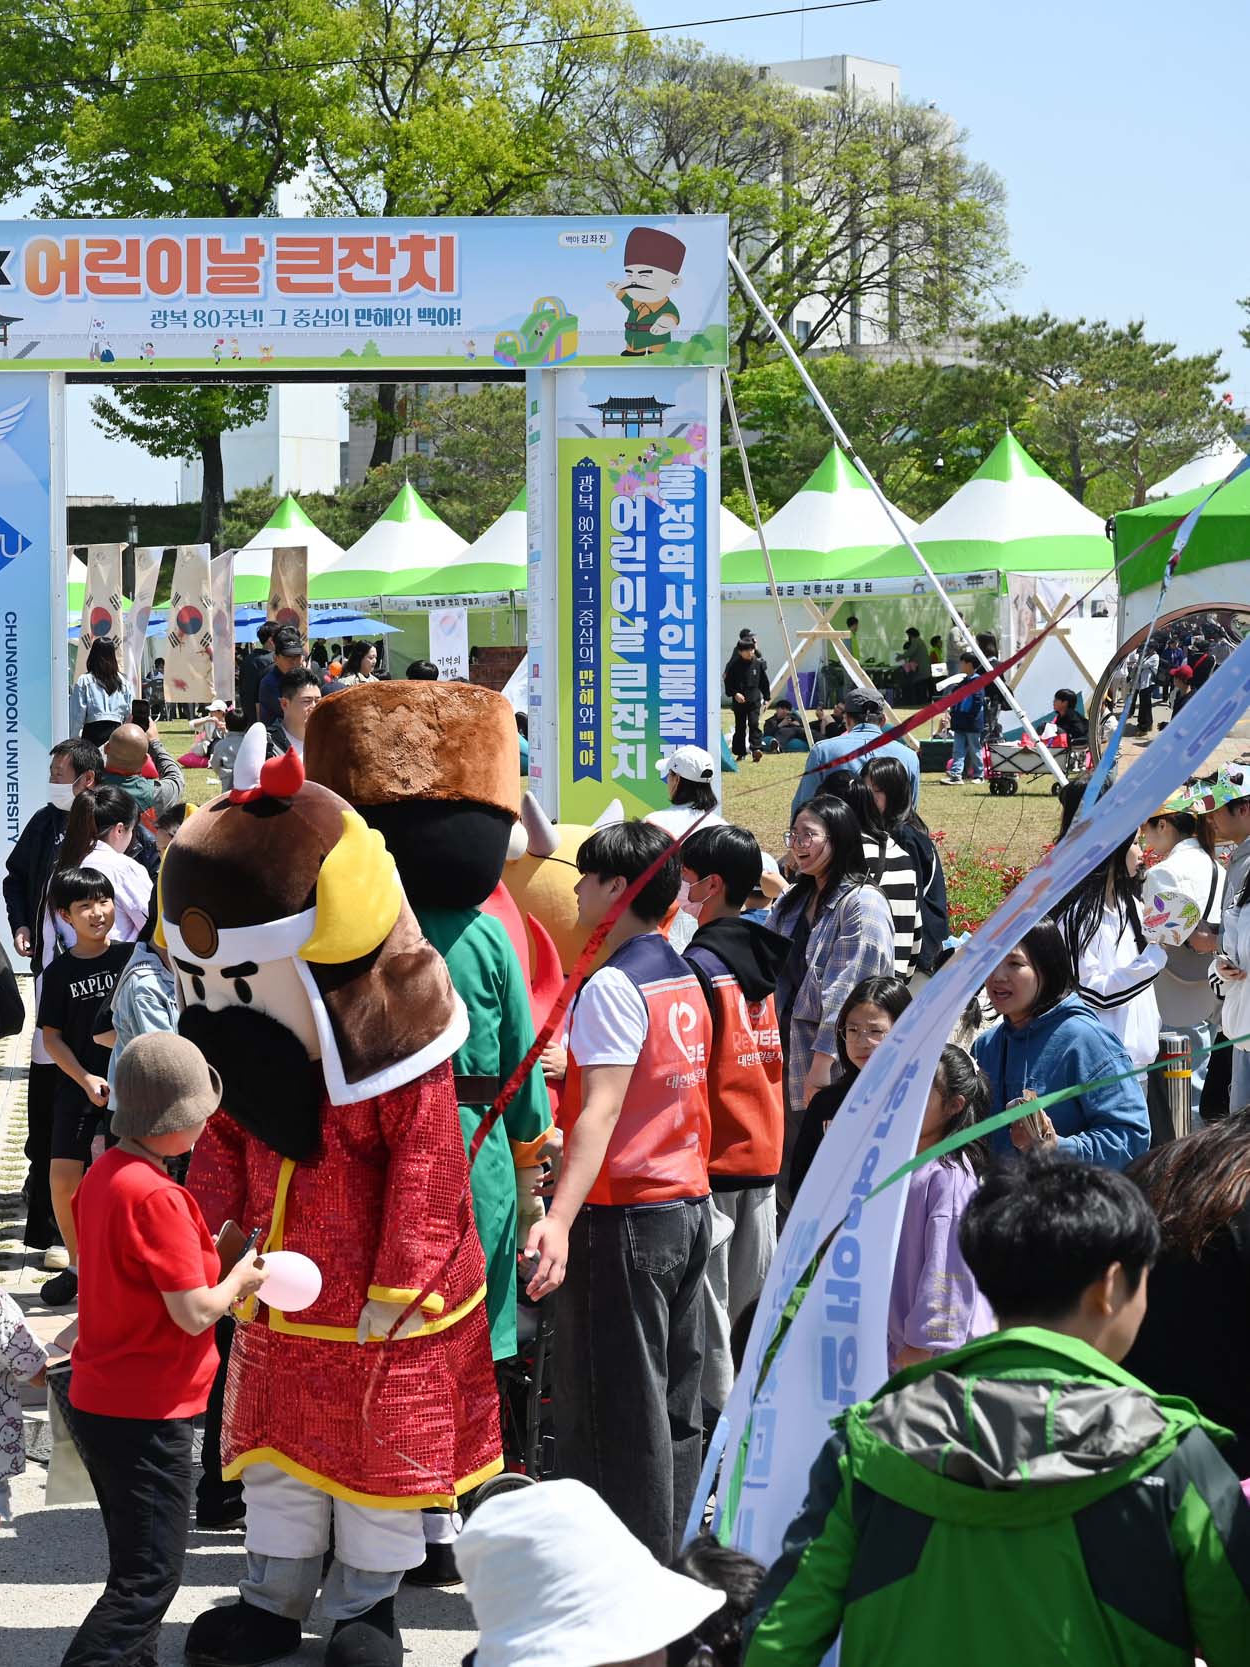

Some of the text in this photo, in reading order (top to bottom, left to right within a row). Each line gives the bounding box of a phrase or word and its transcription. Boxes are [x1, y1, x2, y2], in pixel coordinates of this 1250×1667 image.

[24, 237, 265, 296] 어린이날
[276, 235, 455, 294] 큰잔치
[149, 306, 461, 329] 광복 80주년! 그 중심의 만해와 백야!
[578, 475, 595, 767] 광복 80주년 그 중심의 만해와 백야
[610, 495, 649, 780] 어린이날 큰잔치
[437, 655, 461, 666] 기억의
[5, 611, 19, 844] CHUNGWOON UNIVERSITY
[69, 973, 119, 999] EXPLO
